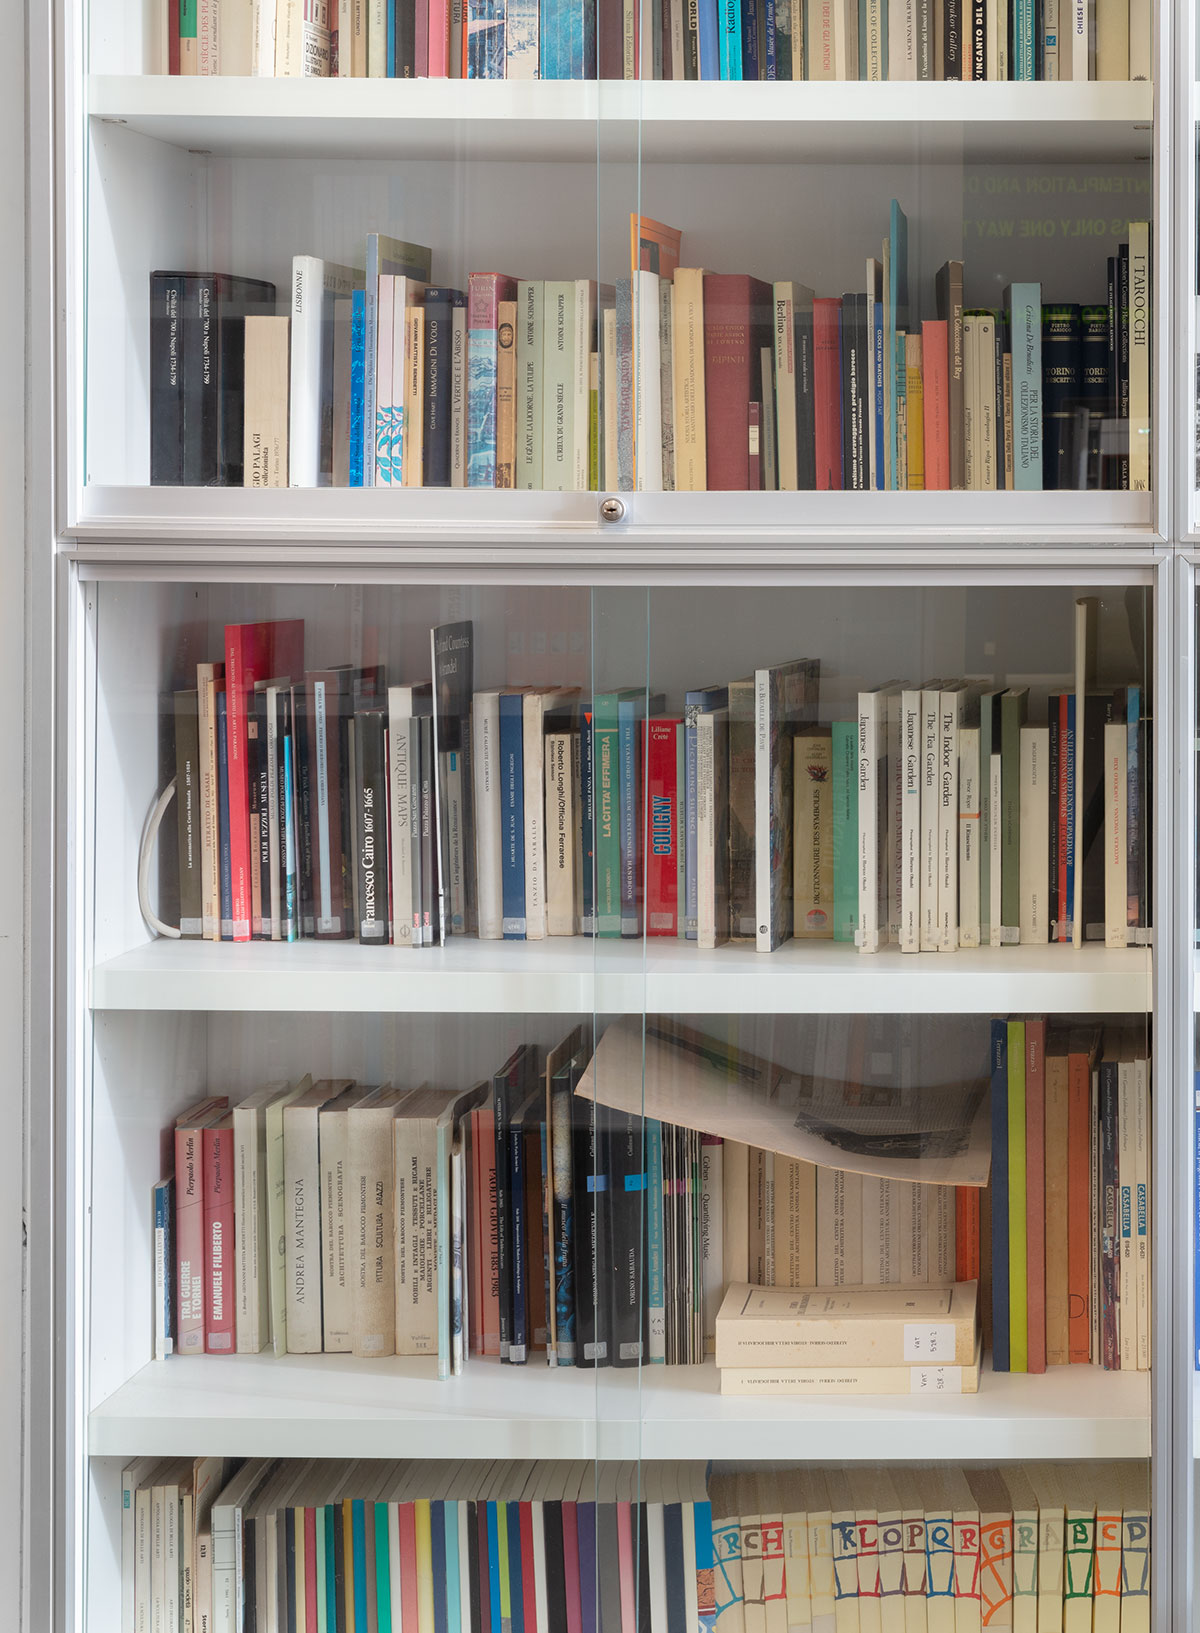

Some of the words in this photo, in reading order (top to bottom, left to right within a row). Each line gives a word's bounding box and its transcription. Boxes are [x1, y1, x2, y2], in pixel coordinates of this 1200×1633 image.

[822, 6, 831, 18] DEI
[822, 19, 831, 29] DE
[869, 16, 879, 29] OF
[975, 9, 984, 25] DEL
[1076, 6, 1084, 35] CHIESE
[822, 30, 831, 42] GLI
[822, 43, 831, 71] ANTICHI
[869, 31, 879, 82] COLLECTING
[295, 270, 303, 314] LISBONNE
[557, 293, 565, 326] SCHNAPPER
[953, 304, 962, 317] Las
[1025, 304, 1035, 332] Cristina
[557, 326, 565, 352] ANTOINE
[953, 317, 962, 354] Colecciones
[1025, 333, 1035, 344] De
[953, 355, 962, 365] del
[953, 365, 962, 380] Rey
[1025, 344, 1035, 375] Benedictis
[1020, 380, 1029, 436] COLLEZIONISMO
[1028, 389, 1039, 404] PER
[1028, 405, 1039, 416] LA
[555, 404, 565, 425] GRAND
[555, 425, 565, 435] DU
[1028, 416, 1039, 443] STORIA
[555, 434, 565, 462] CURIEUX
[1020, 436, 1029, 469] ITALIANO
[1028, 445, 1039, 462] DEL
[858, 713, 870, 754] Japanese
[925, 711, 936, 730] The
[941, 712, 953, 733] The
[555, 739, 567, 770] Roberto
[925, 733, 936, 750] Tea
[941, 735, 953, 768] Indoor
[394, 733, 408, 790] ANTIQUE
[858, 758, 870, 791] Garden
[925, 752, 936, 787] Garden
[555, 771, 567, 831] Longhi/Officina
[941, 771, 953, 807] Garden
[361, 787, 376, 833] 1607-1665
[398, 794, 409, 827] MAPS
[651, 794, 672, 856] COLIGNY
[812, 789, 821, 831] SYMBOLES
[361, 835, 376, 869] Cairo
[555, 832, 567, 869] Ferrarese
[812, 831, 821, 846] DES
[812, 846, 821, 905] DICTIONNAIRE
[361, 870, 376, 929] Francesco
[185, 1137, 195, 1161] Merlin
[213, 1137, 222, 1161] Merlin
[185, 1163, 196, 1196] Pierpaolo
[213, 1163, 223, 1194] Pierpaolo
[375, 1180, 384, 1206] ARAZZI
[295, 1178, 306, 1249] MANTEGNA
[212, 1221, 224, 1269] FILIBERTO
[375, 1212, 384, 1249] SCULTURA
[180, 1260, 191, 1298] GUERRE
[375, 1256, 384, 1283] PITTURA
[628, 1247, 637, 1280] SABAUDA
[191, 1275, 202, 1312] TORNEI
[212, 1270, 224, 1320] EMANUELE
[295, 1255, 306, 1305] ANDREA
[628, 1280, 637, 1305] TORINO
[180, 1299, 191, 1320] TRA
